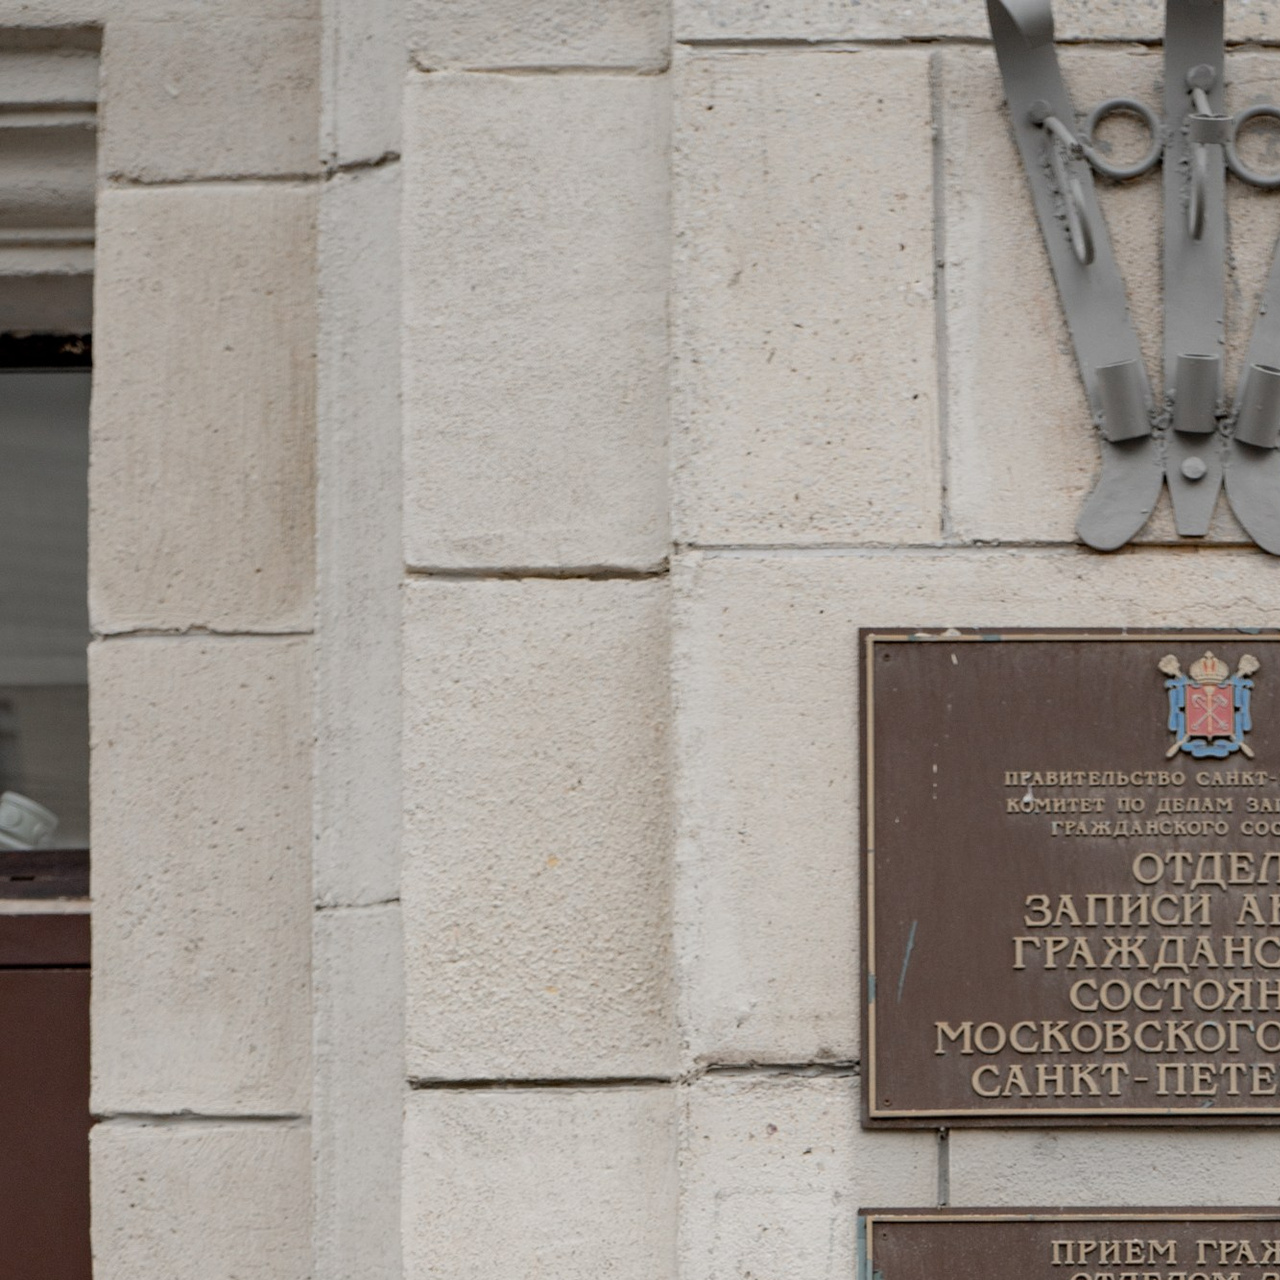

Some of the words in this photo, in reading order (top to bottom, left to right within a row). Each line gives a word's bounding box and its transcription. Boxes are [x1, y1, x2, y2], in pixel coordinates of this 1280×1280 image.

[1004, 771, 1186, 787] ПРАВИТЕЛЬСТВО
[1006, 798, 1106, 814] КОМИТЕТ
[1117, 798, 1146, 814] ПО
[1156, 798, 1233, 816] ДЕЛАМ
[1051, 821, 1229, 838] ГРАЖДАНСКОГО
[1024, 893, 1212, 927] ЗАПИСИ
[1051, 1238, 1177, 1266] ПРИЕМ
